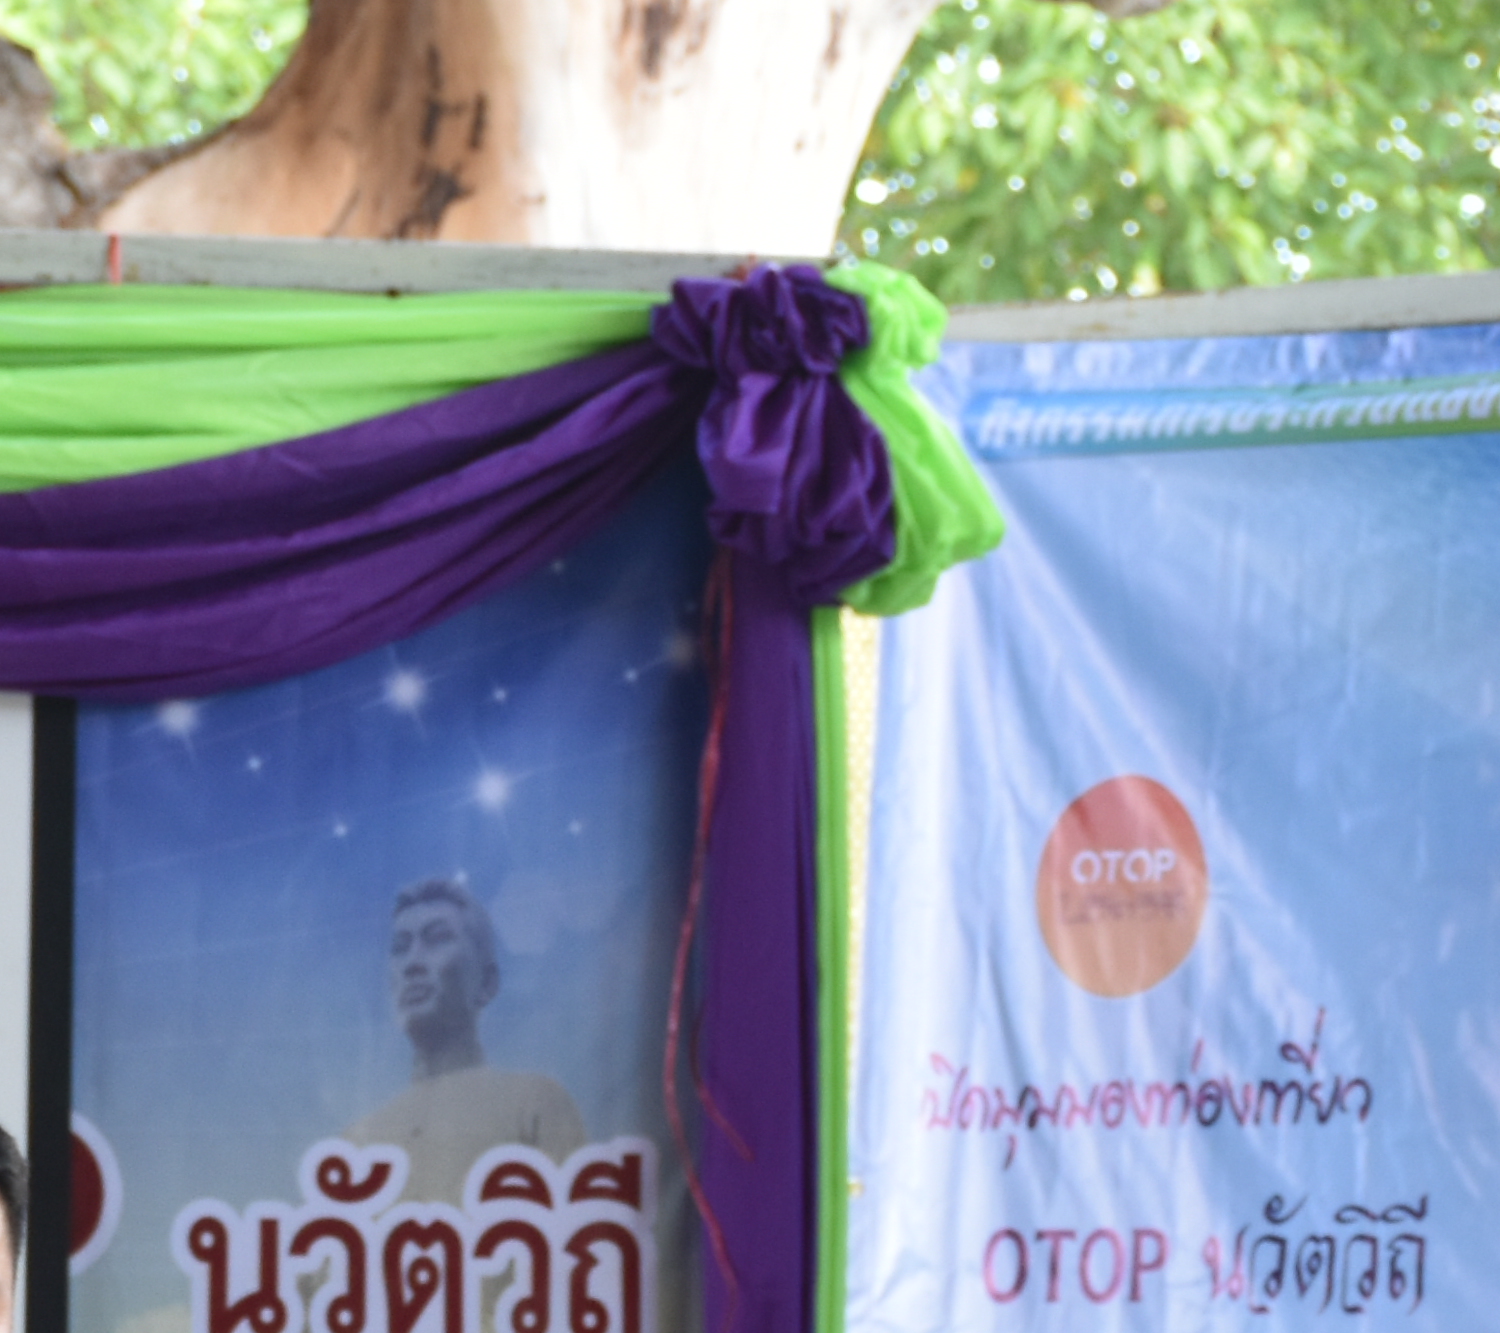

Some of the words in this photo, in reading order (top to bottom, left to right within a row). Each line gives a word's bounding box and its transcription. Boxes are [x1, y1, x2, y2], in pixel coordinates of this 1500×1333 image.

[1071, 848, 1176, 885] OTOP
[983, 1228, 1170, 1304] OTOP
[1203, 1196, 1429, 1314] นวัตวิถี
